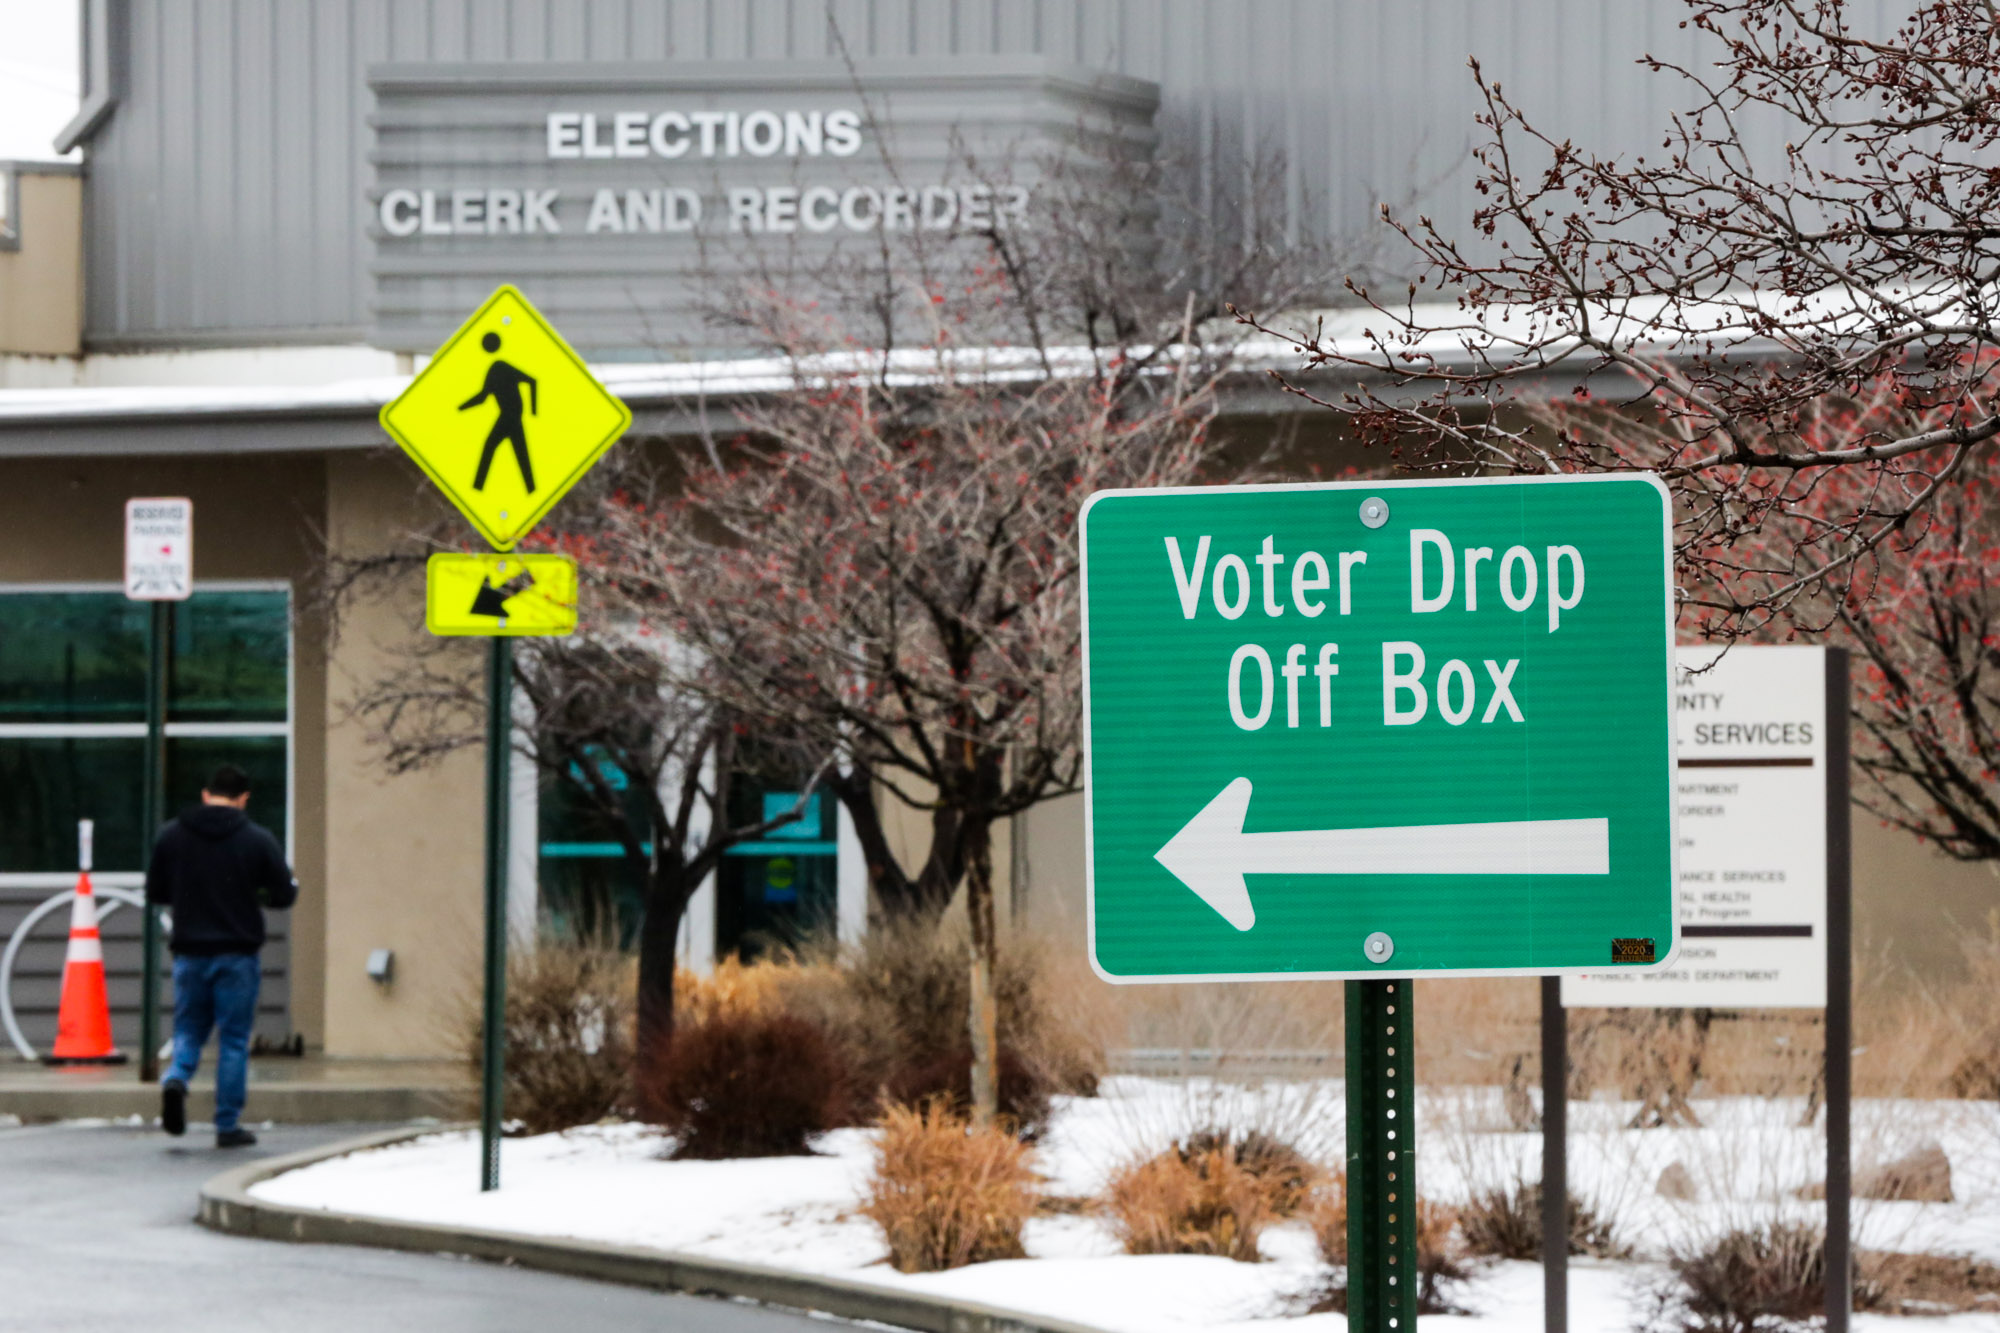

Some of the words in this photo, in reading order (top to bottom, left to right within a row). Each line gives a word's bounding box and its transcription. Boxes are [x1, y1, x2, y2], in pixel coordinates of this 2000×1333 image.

[547, 111, 861, 158] ELECTIONS
[381, 189, 560, 235] CLERK
[586, 187, 702, 233] AND
[730, 184, 1030, 232] RECORDER
[1164, 535, 1367, 620] Voter
[1409, 529, 1585, 634] Drop
[1228, 643, 1339, 731] Off
[1382, 641, 1525, 726] Box
[1677, 692, 1724, 711] NTY
[1695, 723, 1813, 746] SERVICES
[1678, 783, 1739, 796] ARTMENT
[1678, 804, 1725, 818] ORDER
[1680, 870, 1715, 883] ANCE
[1722, 870, 1785, 883] SERVICES
[1702, 891, 1751, 902] HEALTH
[1700, 905, 1751, 920] Program
[1621, 945, 1646, 955] 2020
[1681, 947, 1717, 960] ISION
[1695, 969, 1780, 982] DEPARTMENT
